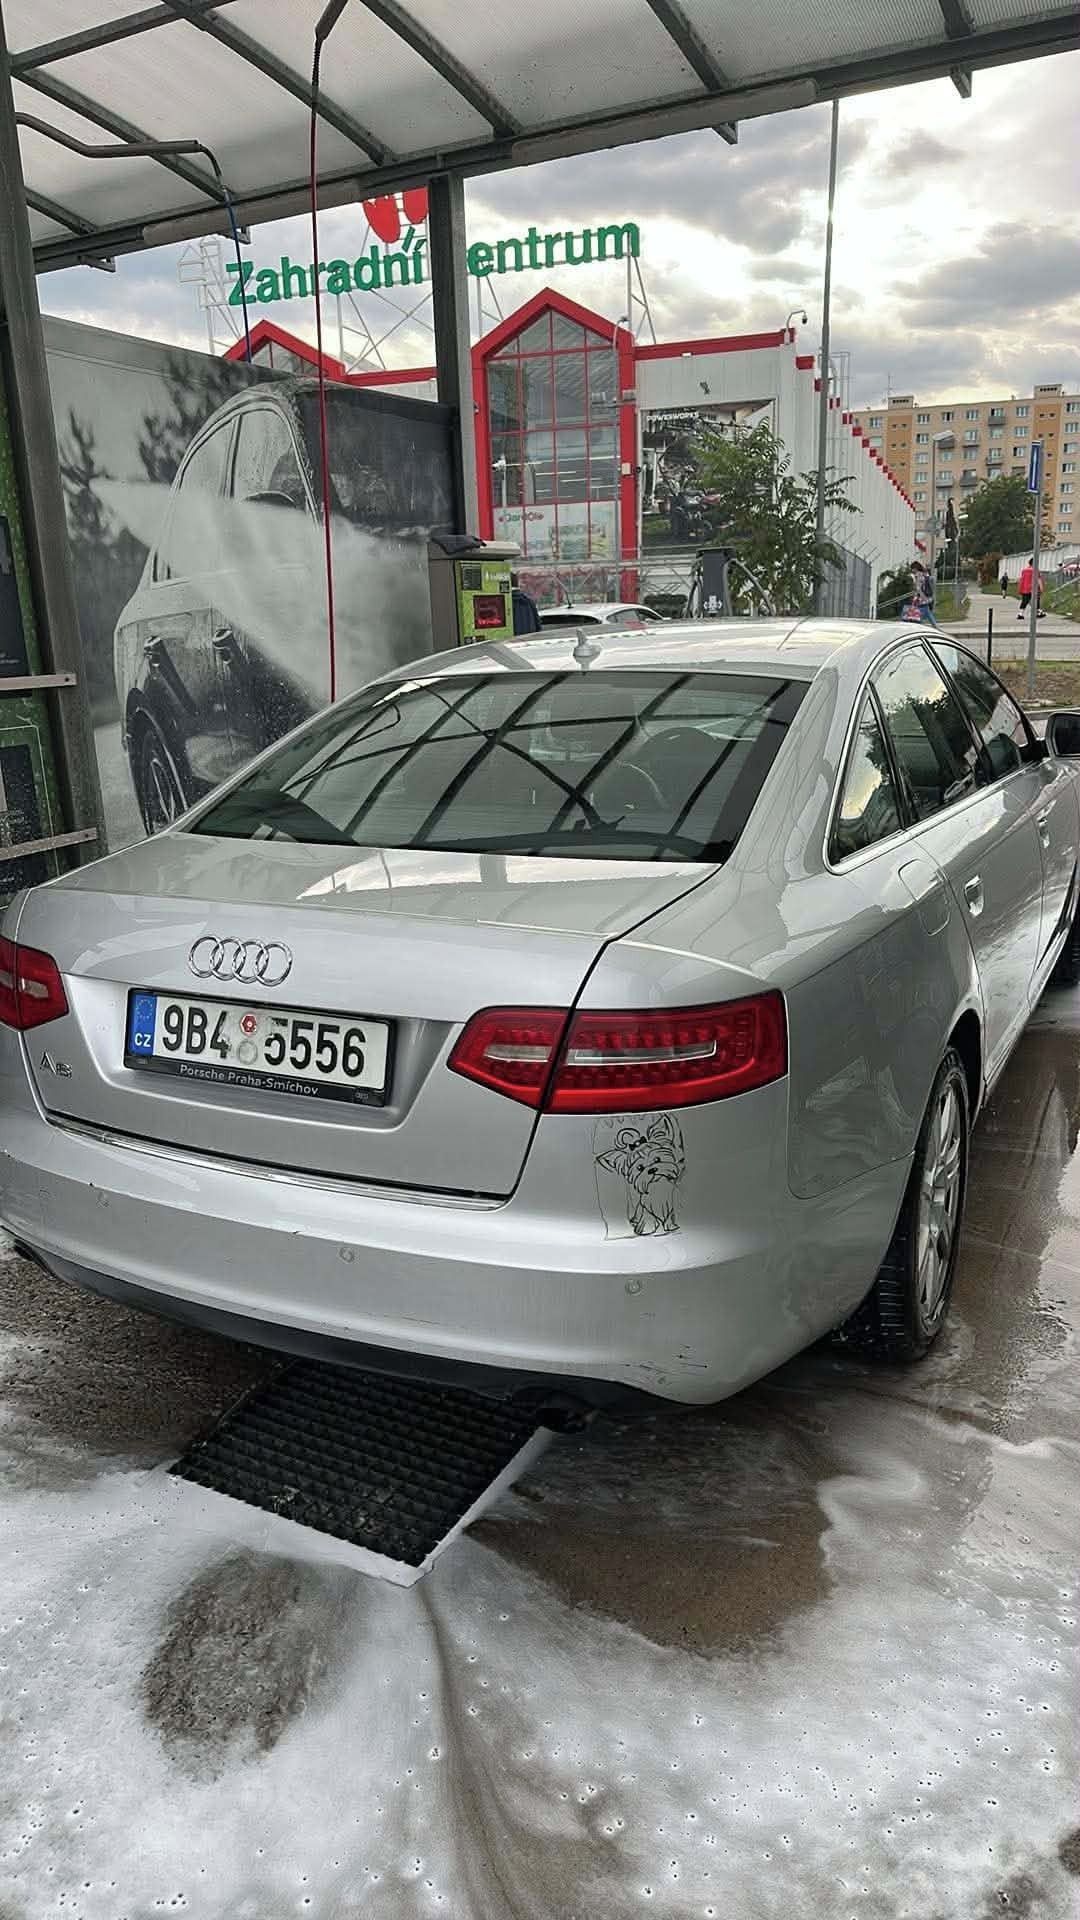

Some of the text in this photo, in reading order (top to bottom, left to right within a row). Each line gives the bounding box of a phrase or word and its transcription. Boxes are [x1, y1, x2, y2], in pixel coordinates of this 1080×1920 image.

[226, 222, 640, 306] Zahradní entrum
[134, 1033, 152, 1048] CZ
[162, 1004, 366, 1077] 9B4 5556
[180, 1063, 225, 1079] Porsche
